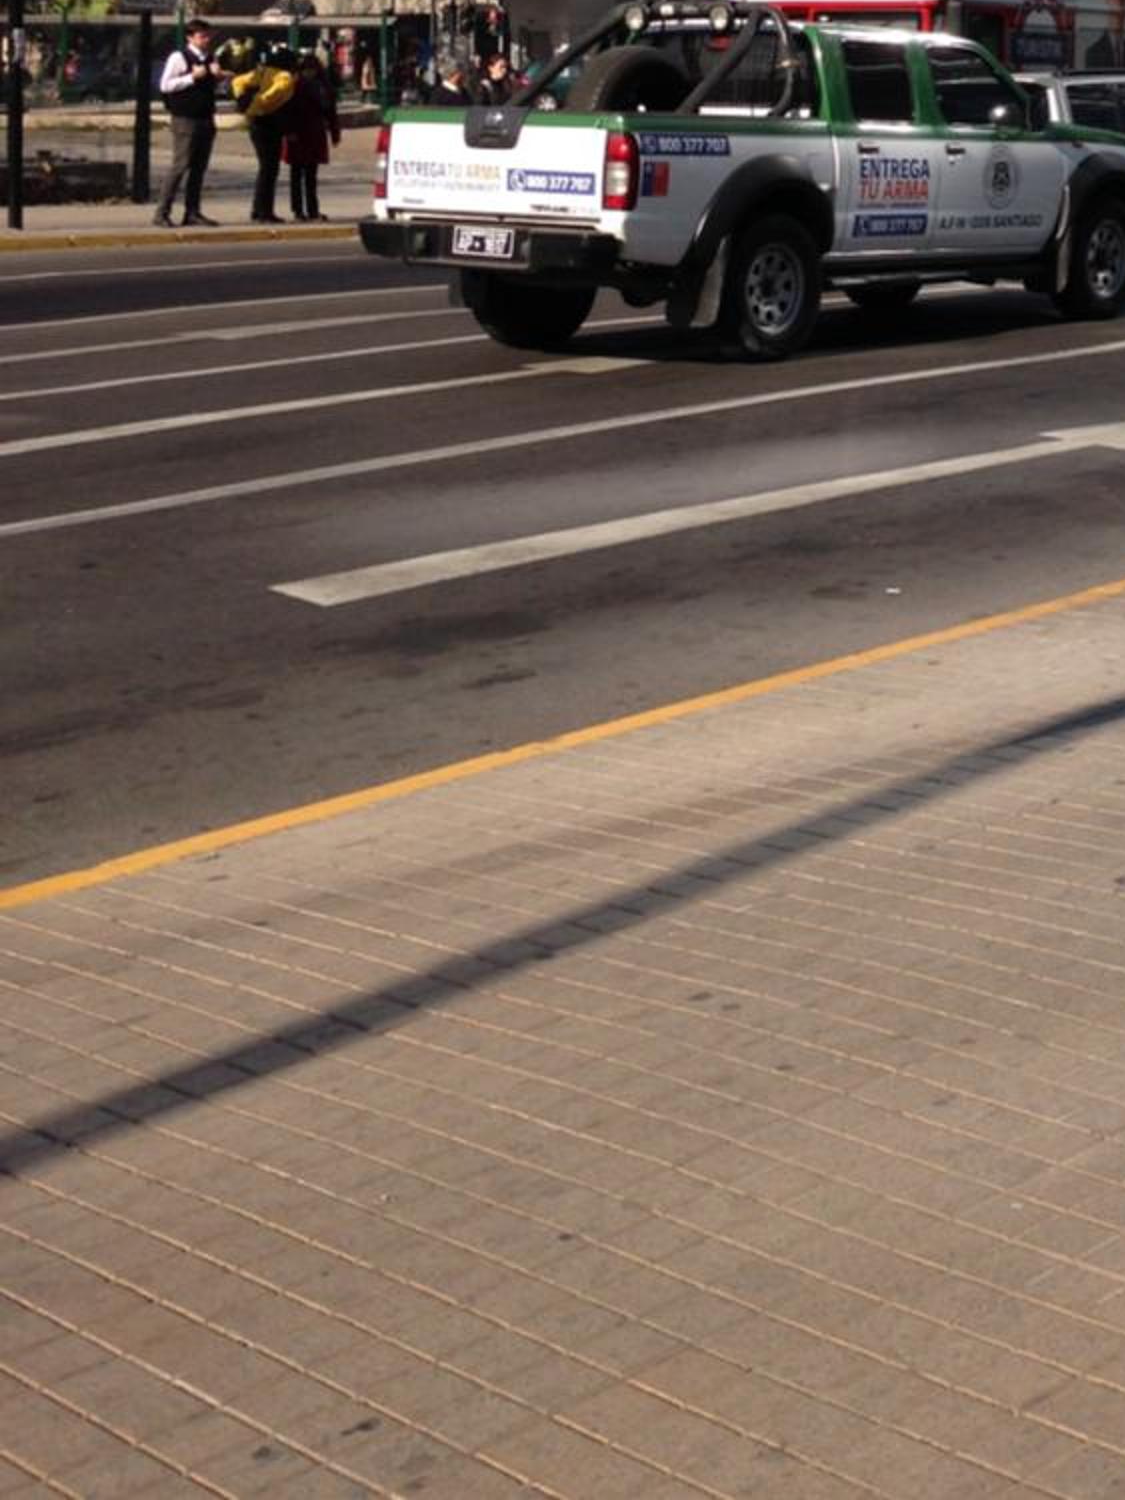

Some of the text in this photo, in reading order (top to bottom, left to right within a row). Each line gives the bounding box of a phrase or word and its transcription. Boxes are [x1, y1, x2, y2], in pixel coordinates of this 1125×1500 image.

[393, 160, 446, 177] ENTREGA
[466, 165, 501, 180] ARMA
[860, 158, 930, 179] ENTREGA
[526, 173, 548, 189] 800
[548, 174, 568, 191] 377
[860, 180, 929, 199] TU ARMA
[993, 213, 1043, 227] SANTIAGO
